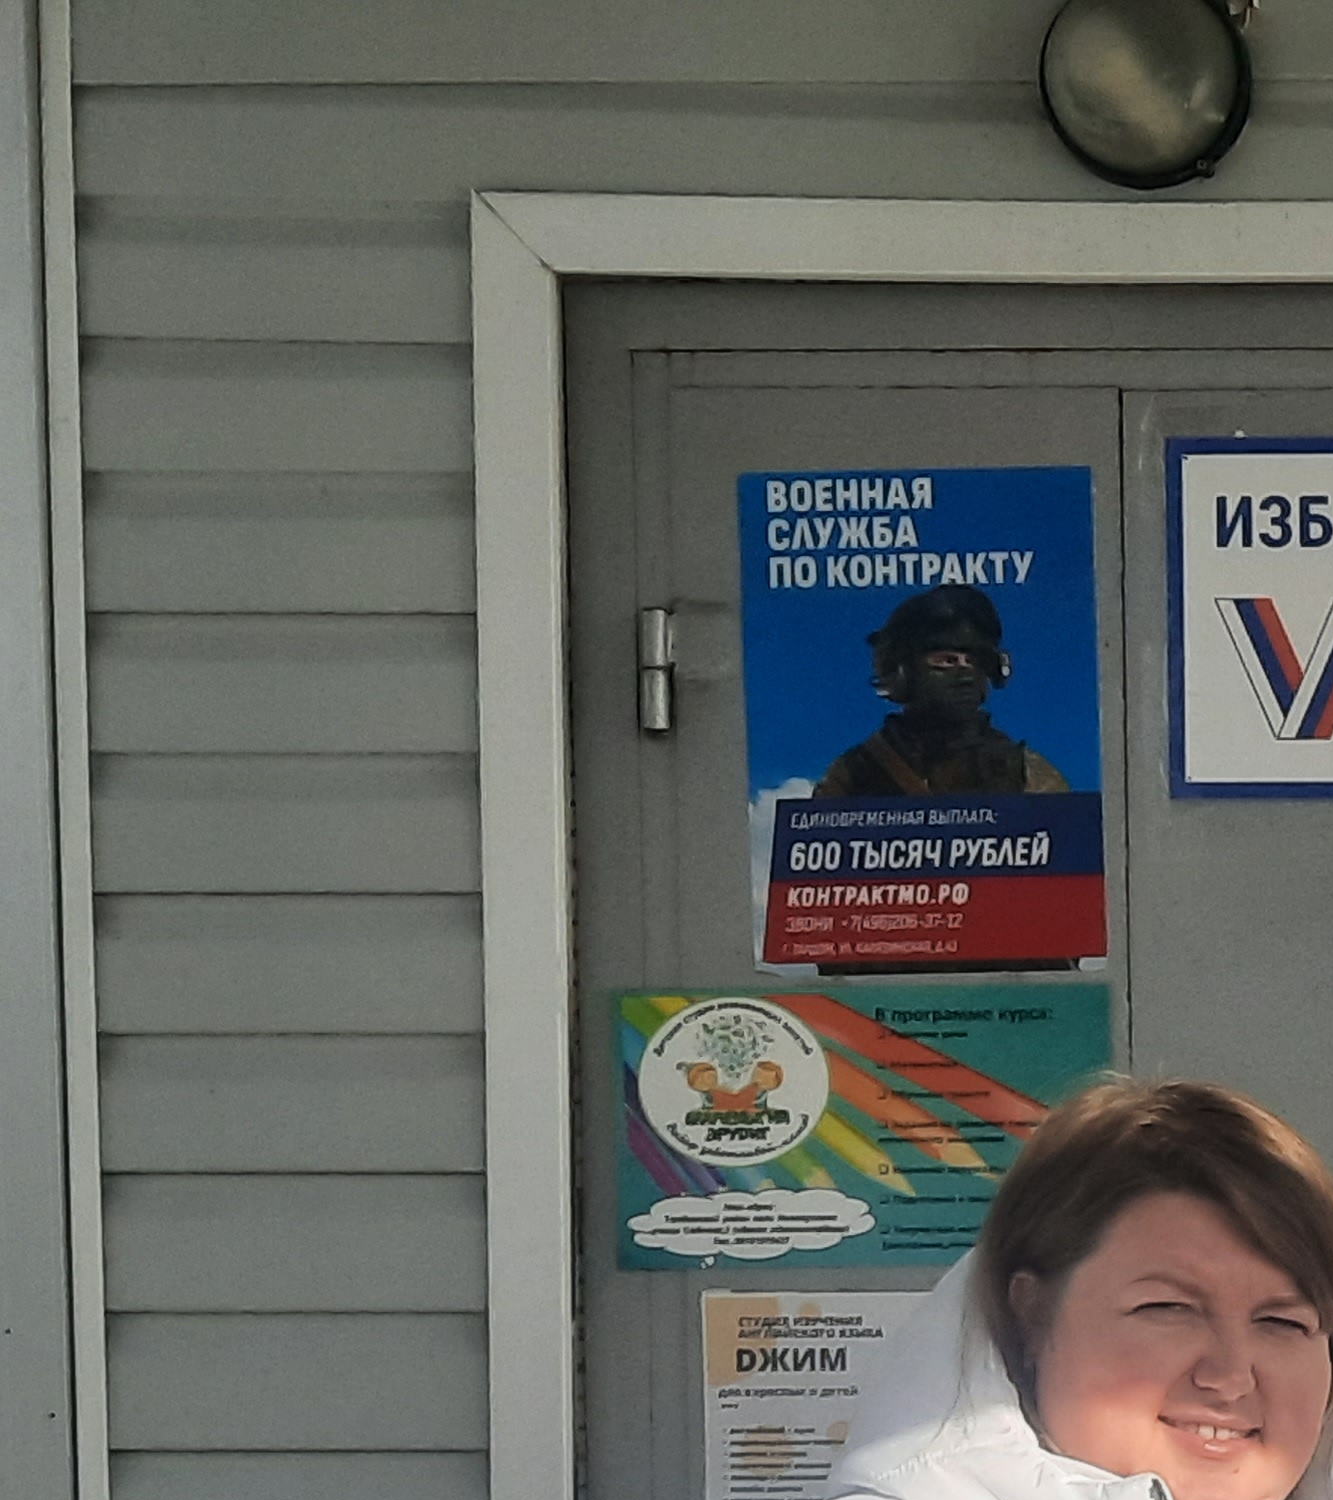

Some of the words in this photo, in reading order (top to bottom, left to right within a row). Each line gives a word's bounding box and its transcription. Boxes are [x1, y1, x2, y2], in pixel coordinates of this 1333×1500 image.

[766, 477, 933, 513] ВОЕННАЯ
[767, 515, 919, 551] СЛУЖБА
[769, 556, 818, 589] ПО
[827, 551, 1034, 588] КОНТРАКТУ
[791, 811, 925, 829] ЕДИНОВРЕМЕННАЯ
[790, 841, 841, 871] 600
[850, 839, 943, 869] ТЫСЯЧ
[950, 832, 1050, 867] РУБЛЕЙ
[787, 883, 970, 908] КОНТРАКТМО.РФ
